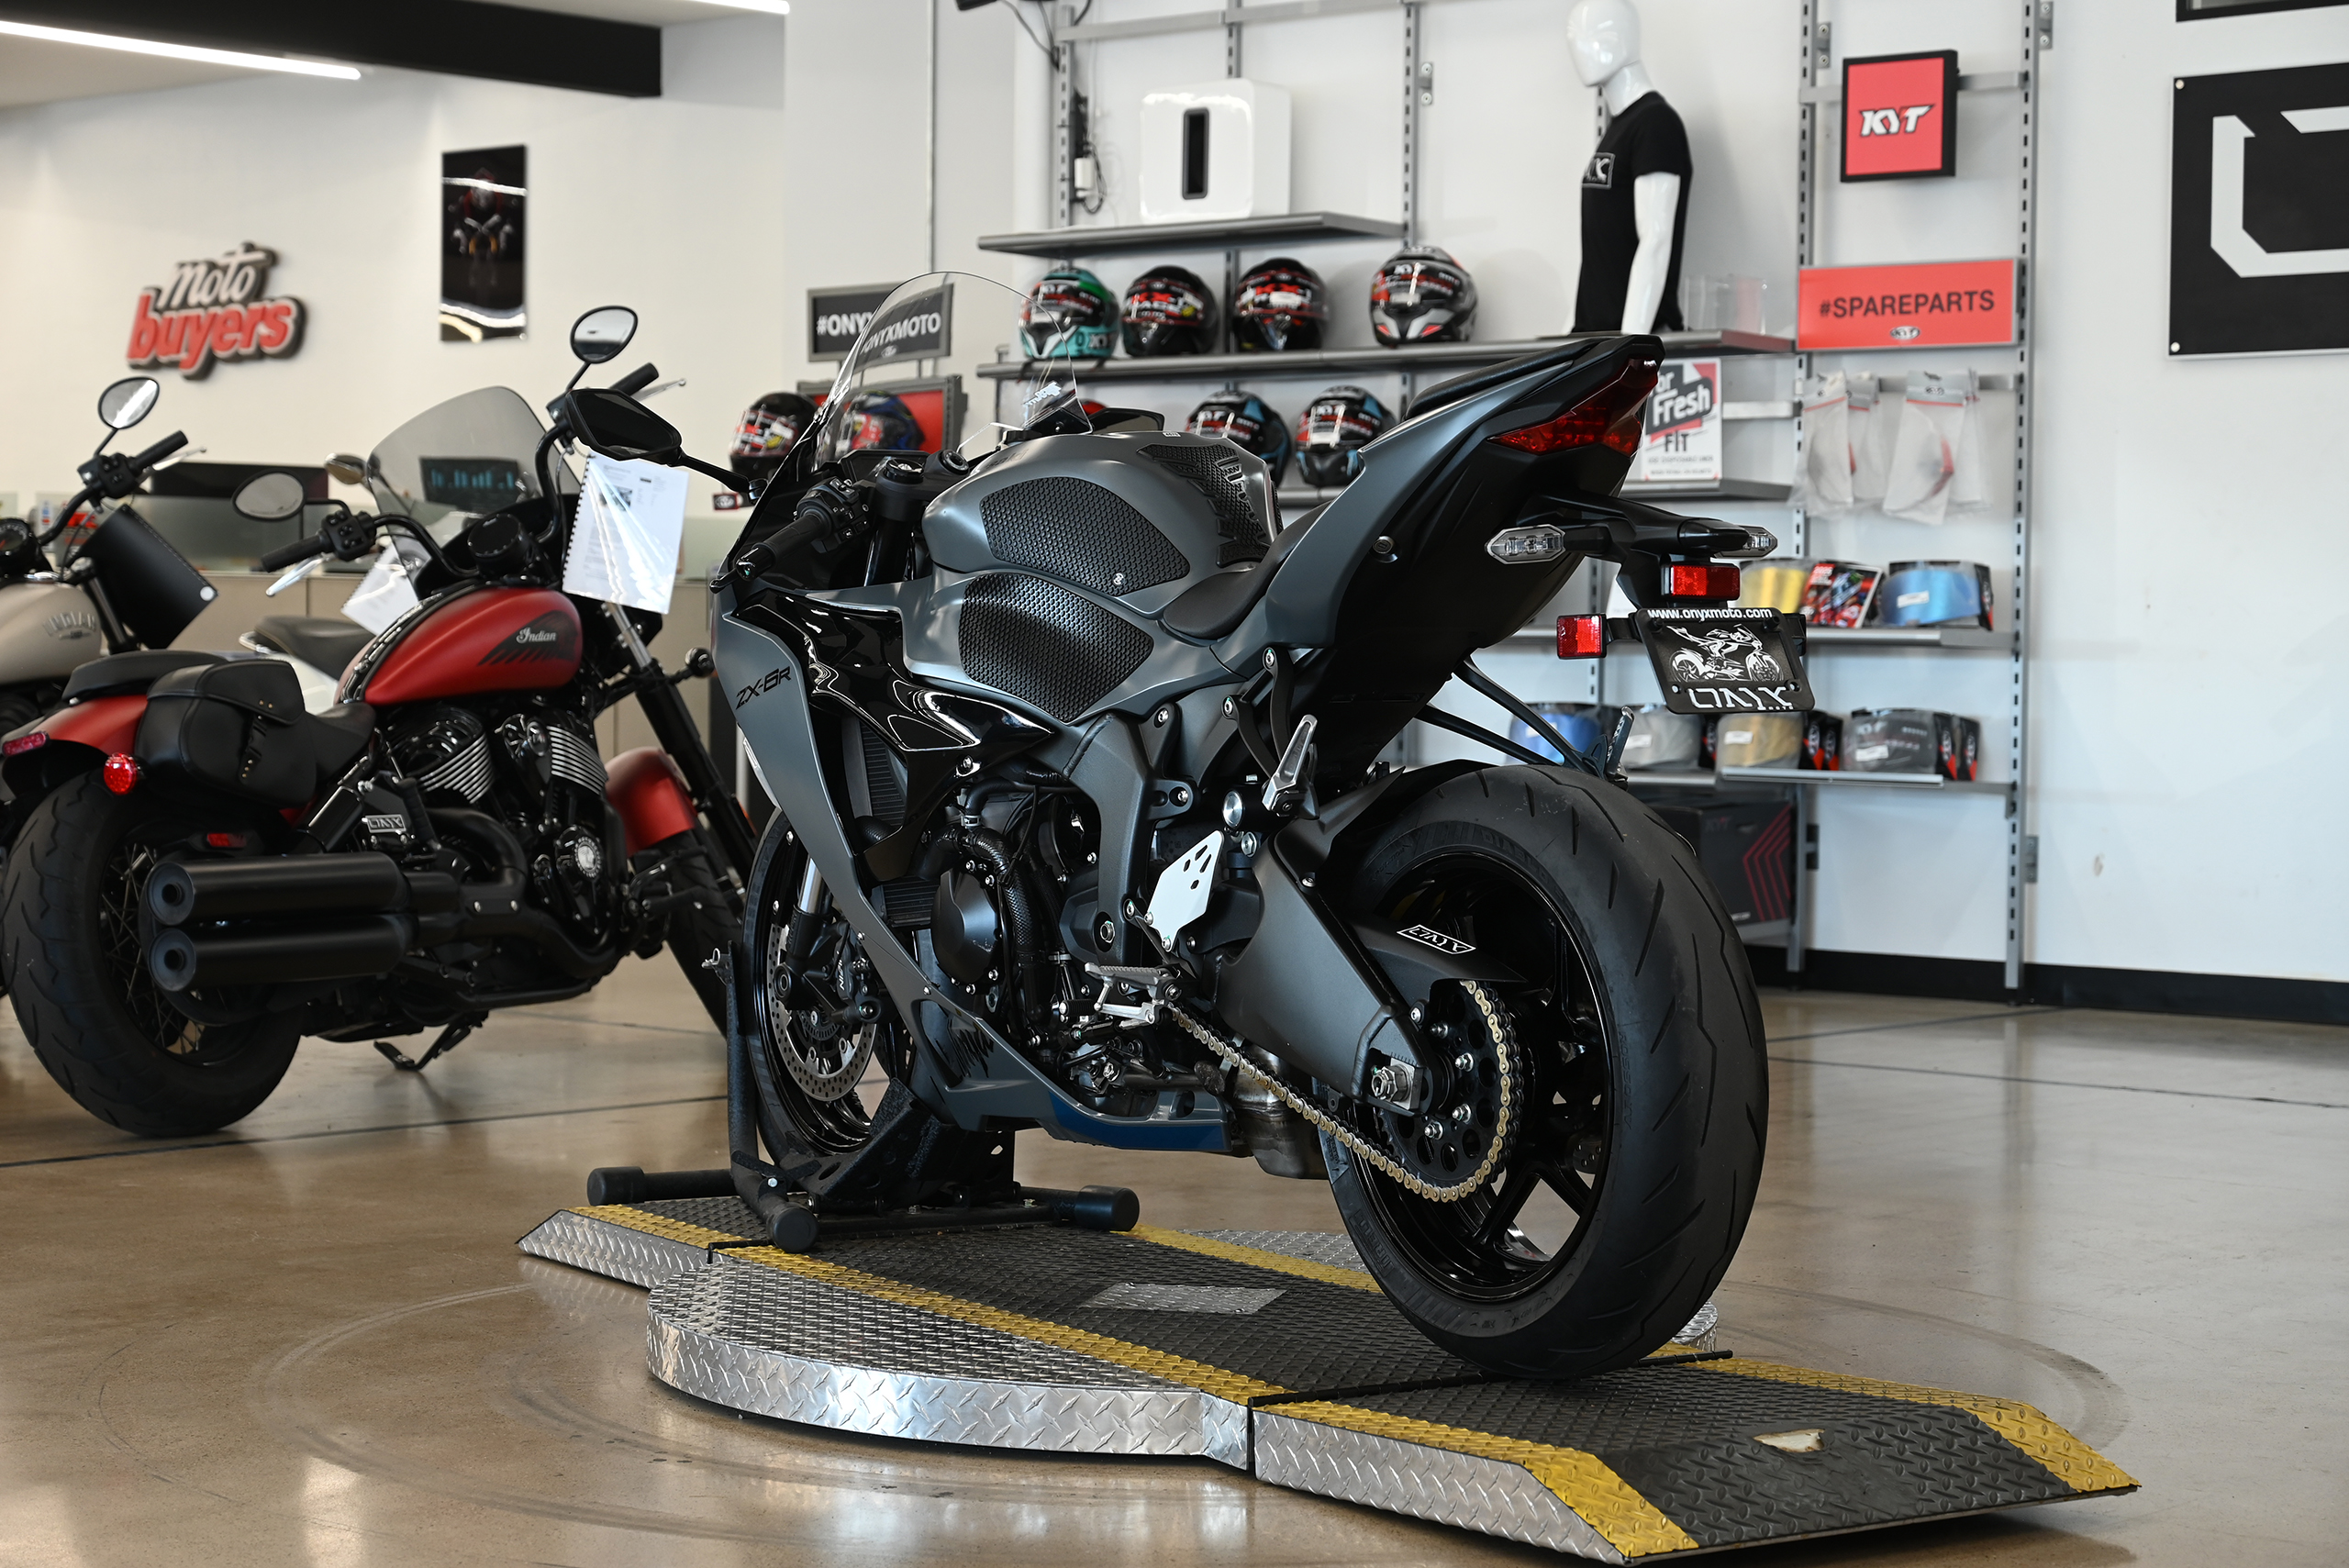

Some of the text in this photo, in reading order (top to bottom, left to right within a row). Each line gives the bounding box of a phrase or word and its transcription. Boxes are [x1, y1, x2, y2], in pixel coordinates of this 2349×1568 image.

[1859, 104, 1935, 137] KYT
[1820, 289, 1995, 318] #SPAREPARTS
[127, 292, 295, 374] buyers
[1653, 384, 1711, 428] Fresh
[1664, 430, 1690, 452] FIT
[1647, 608, 1773, 622] www.onyxmoto.com
[516, 627, 557, 644] Indian
[736, 666, 792, 710] ZX-6R
[1688, 686, 1793, 710] ONYX
